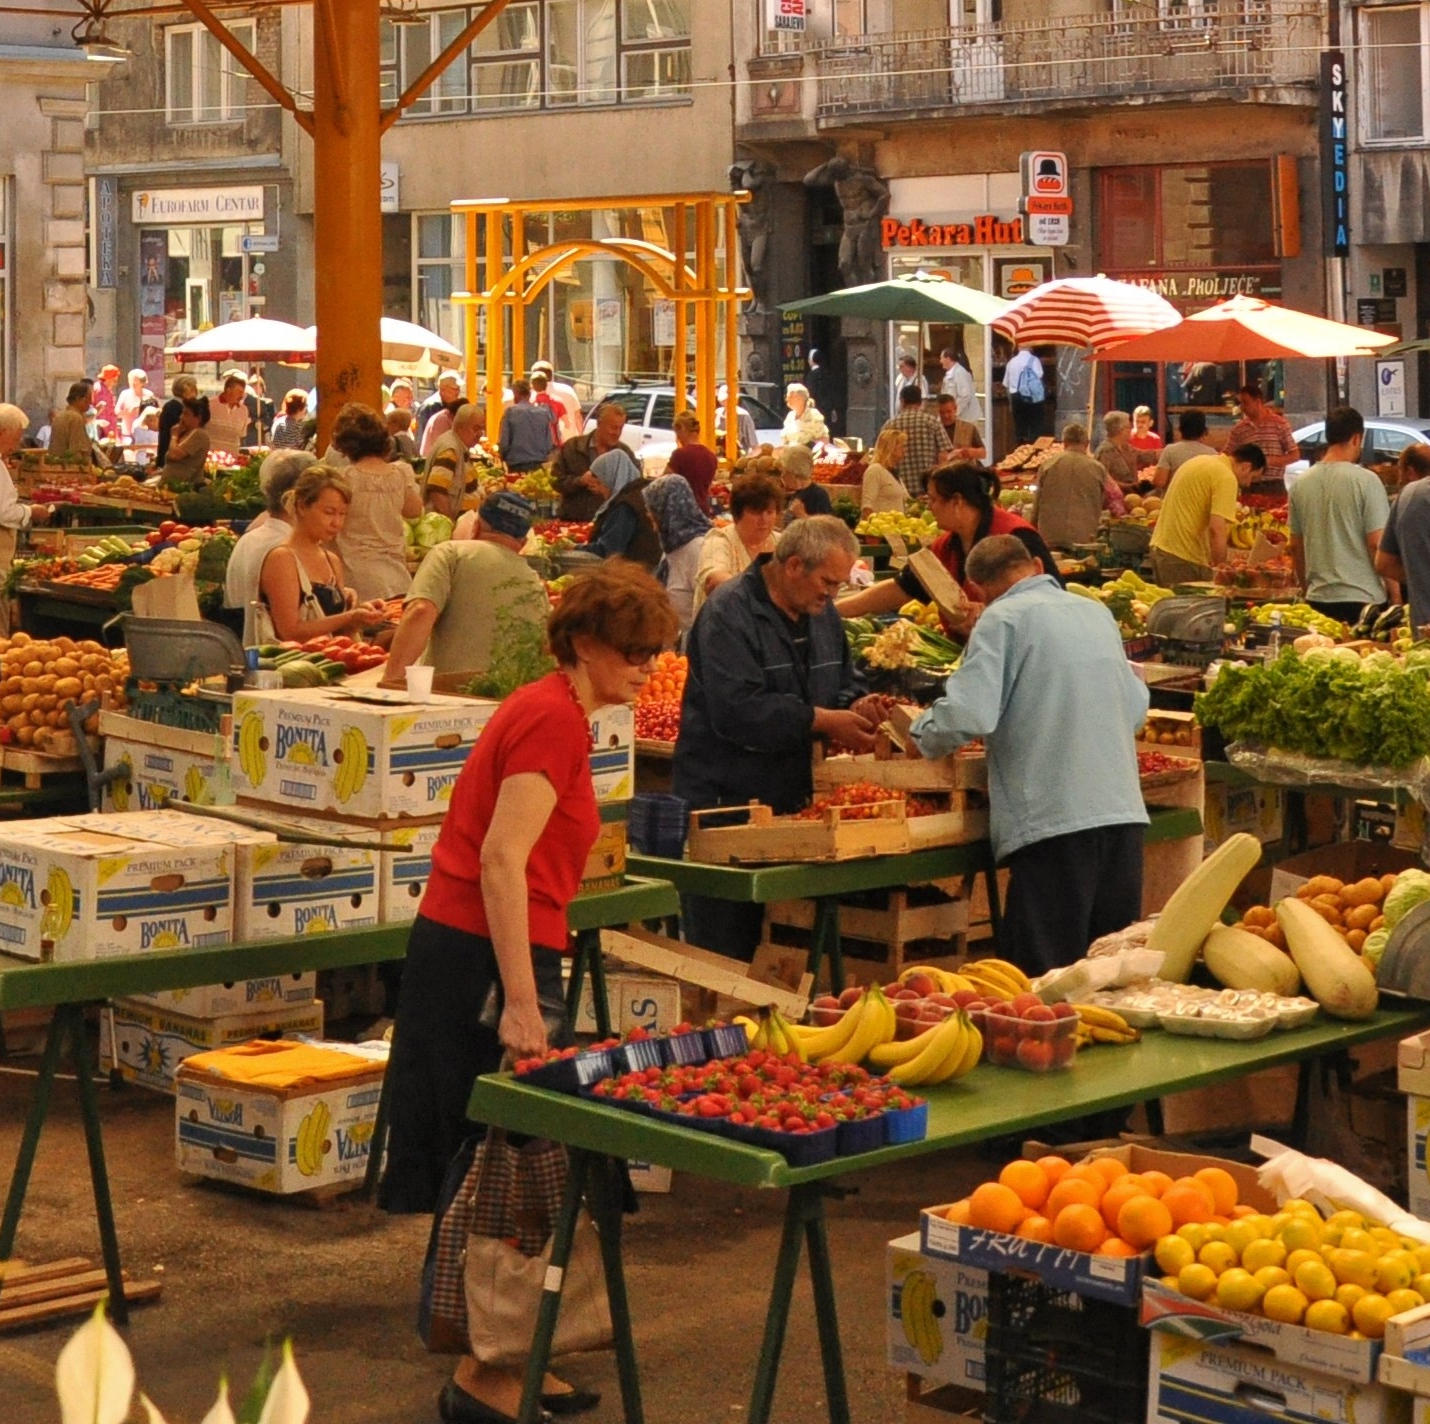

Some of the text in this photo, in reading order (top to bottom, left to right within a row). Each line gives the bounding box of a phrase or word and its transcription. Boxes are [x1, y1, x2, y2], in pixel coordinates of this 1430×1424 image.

[151, 195, 260, 214] EUROFARM CENTAR
[100, 180, 112, 286] APOTEKA
[881, 217, 971, 247] Pekara
[414, 717, 472, 731] PREMIUM PACK
[275, 724, 329, 767] BONITA
[127, 857, 197, 873] PREMIUM PACK
[141, 918, 190, 949] BONITA
[294, 904, 338, 934] BONITA
[957, 1272, 987, 1290] PREM
[955, 1291, 988, 1334] BON
[1200, 1351, 1307, 1391] PREMIUM PACK
